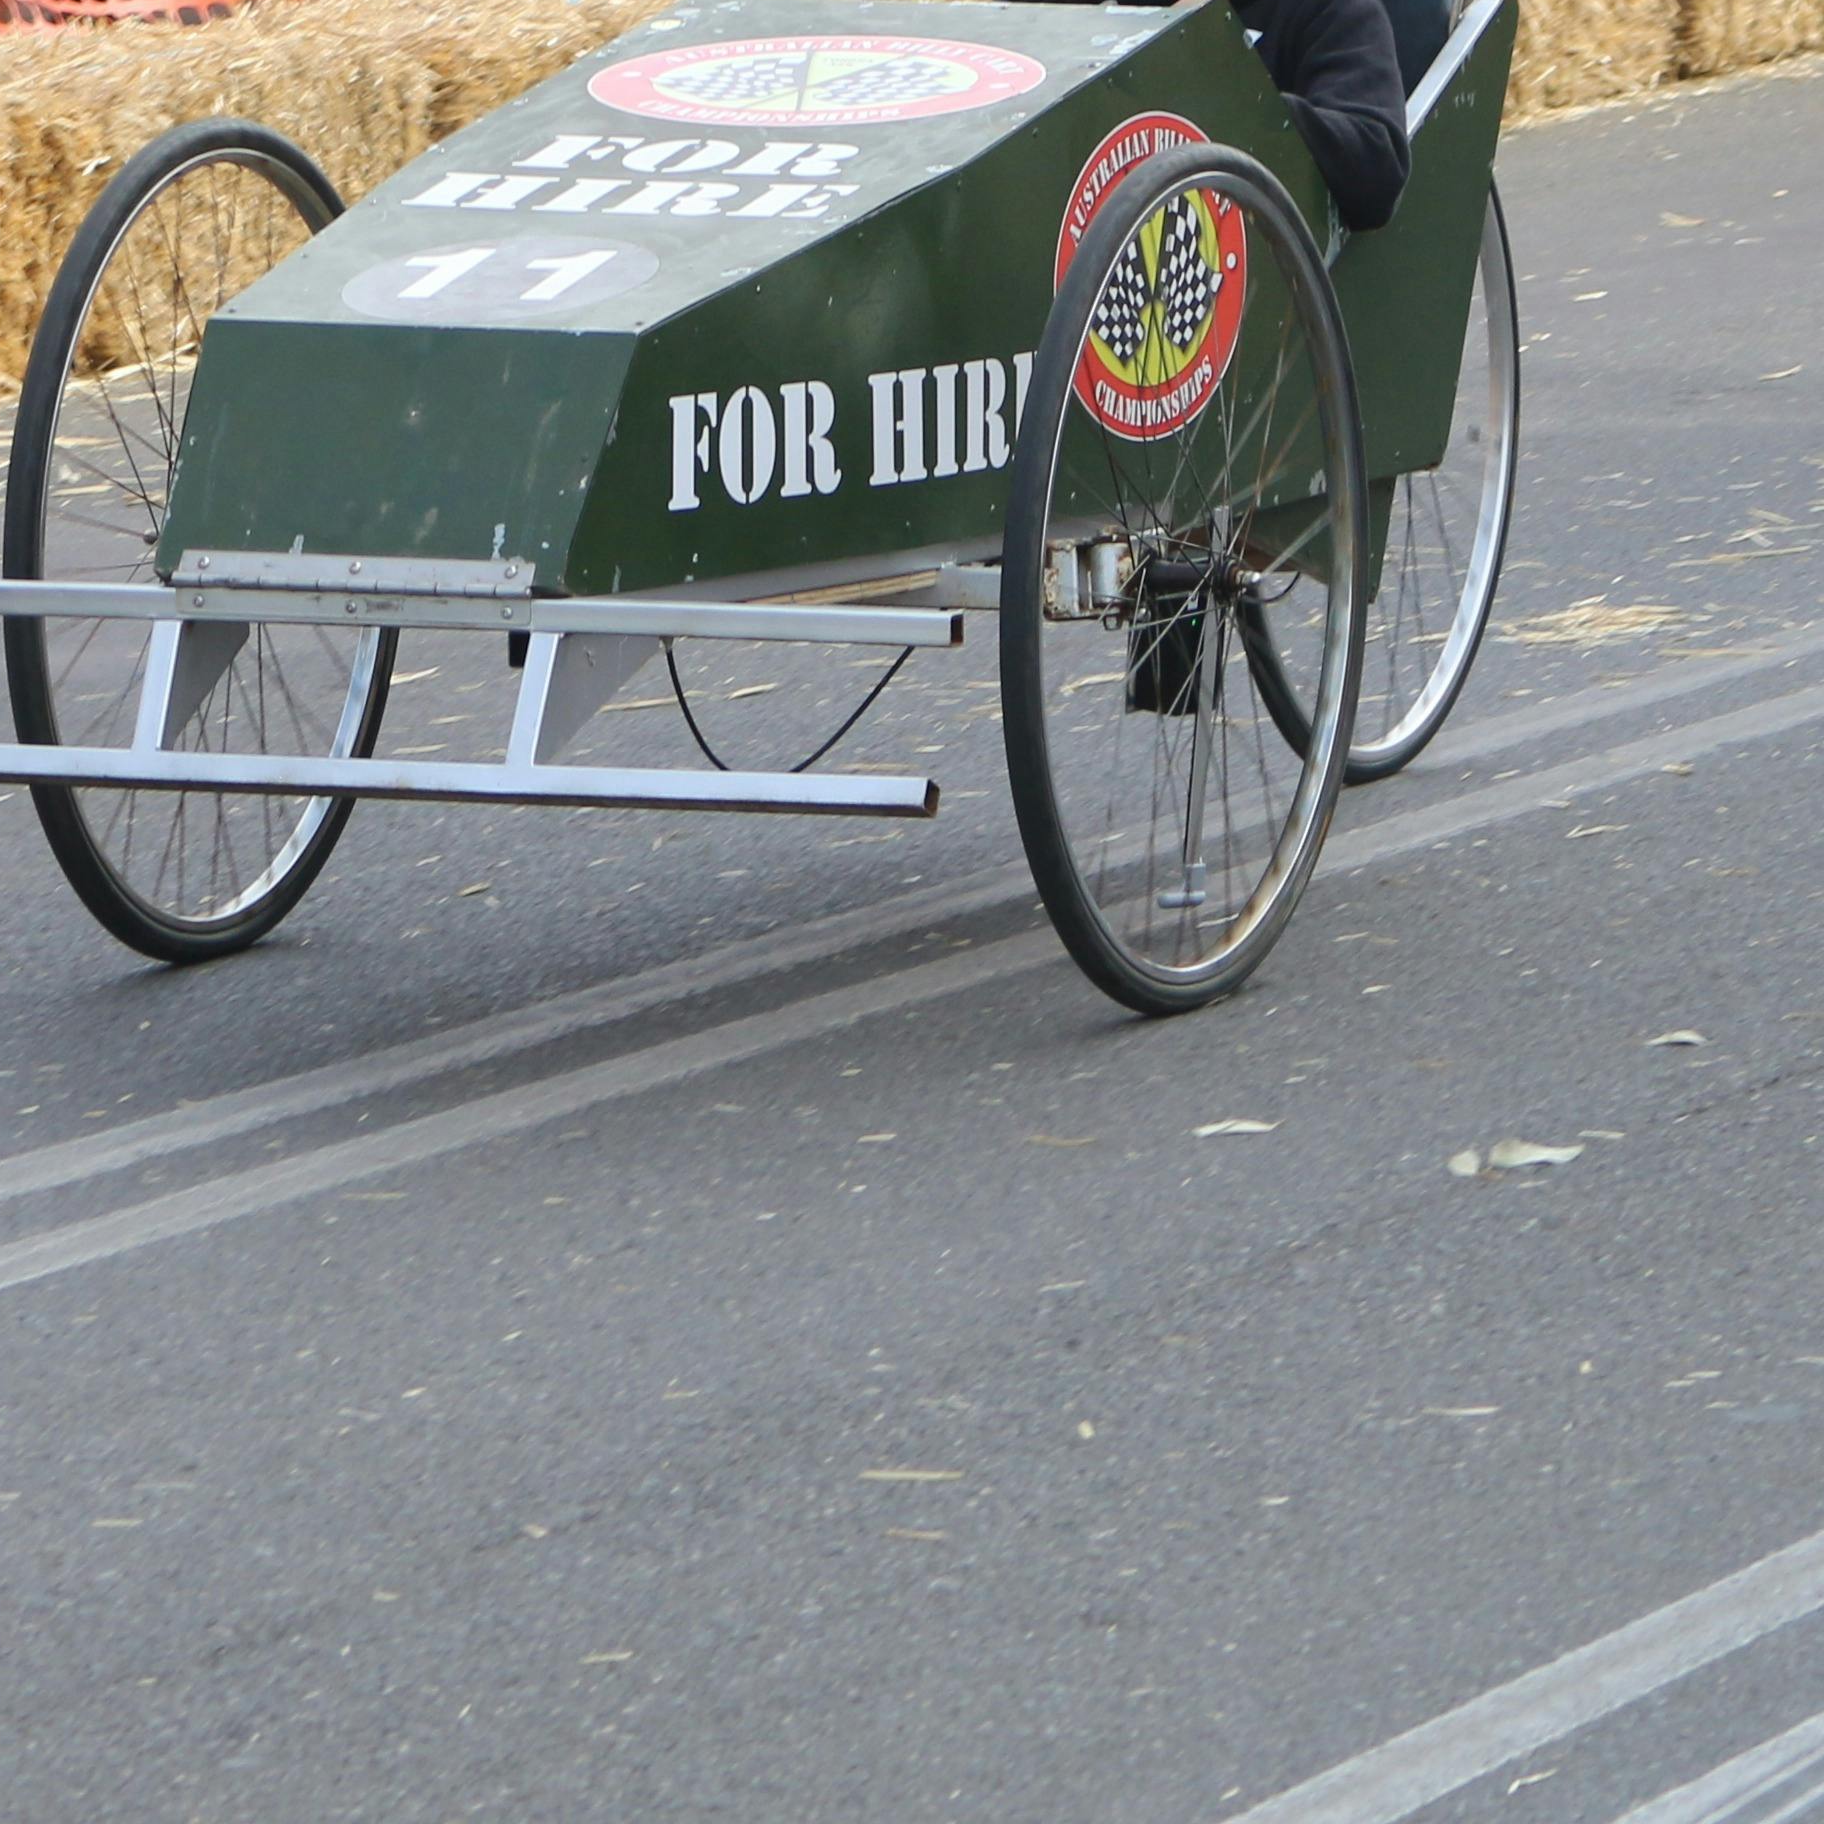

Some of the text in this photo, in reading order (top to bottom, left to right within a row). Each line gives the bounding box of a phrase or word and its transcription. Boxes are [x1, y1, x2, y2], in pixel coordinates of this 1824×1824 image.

[512, 134, 860, 177] FOR
[1069, 127, 1150, 247] AUSTRALIAN
[401, 172, 861, 218] HIRE
[397, 248, 618, 302] 11
[1095, 355, 1214, 428] CHAMPIONSHIPS
[667, 379, 843, 513] FOR
